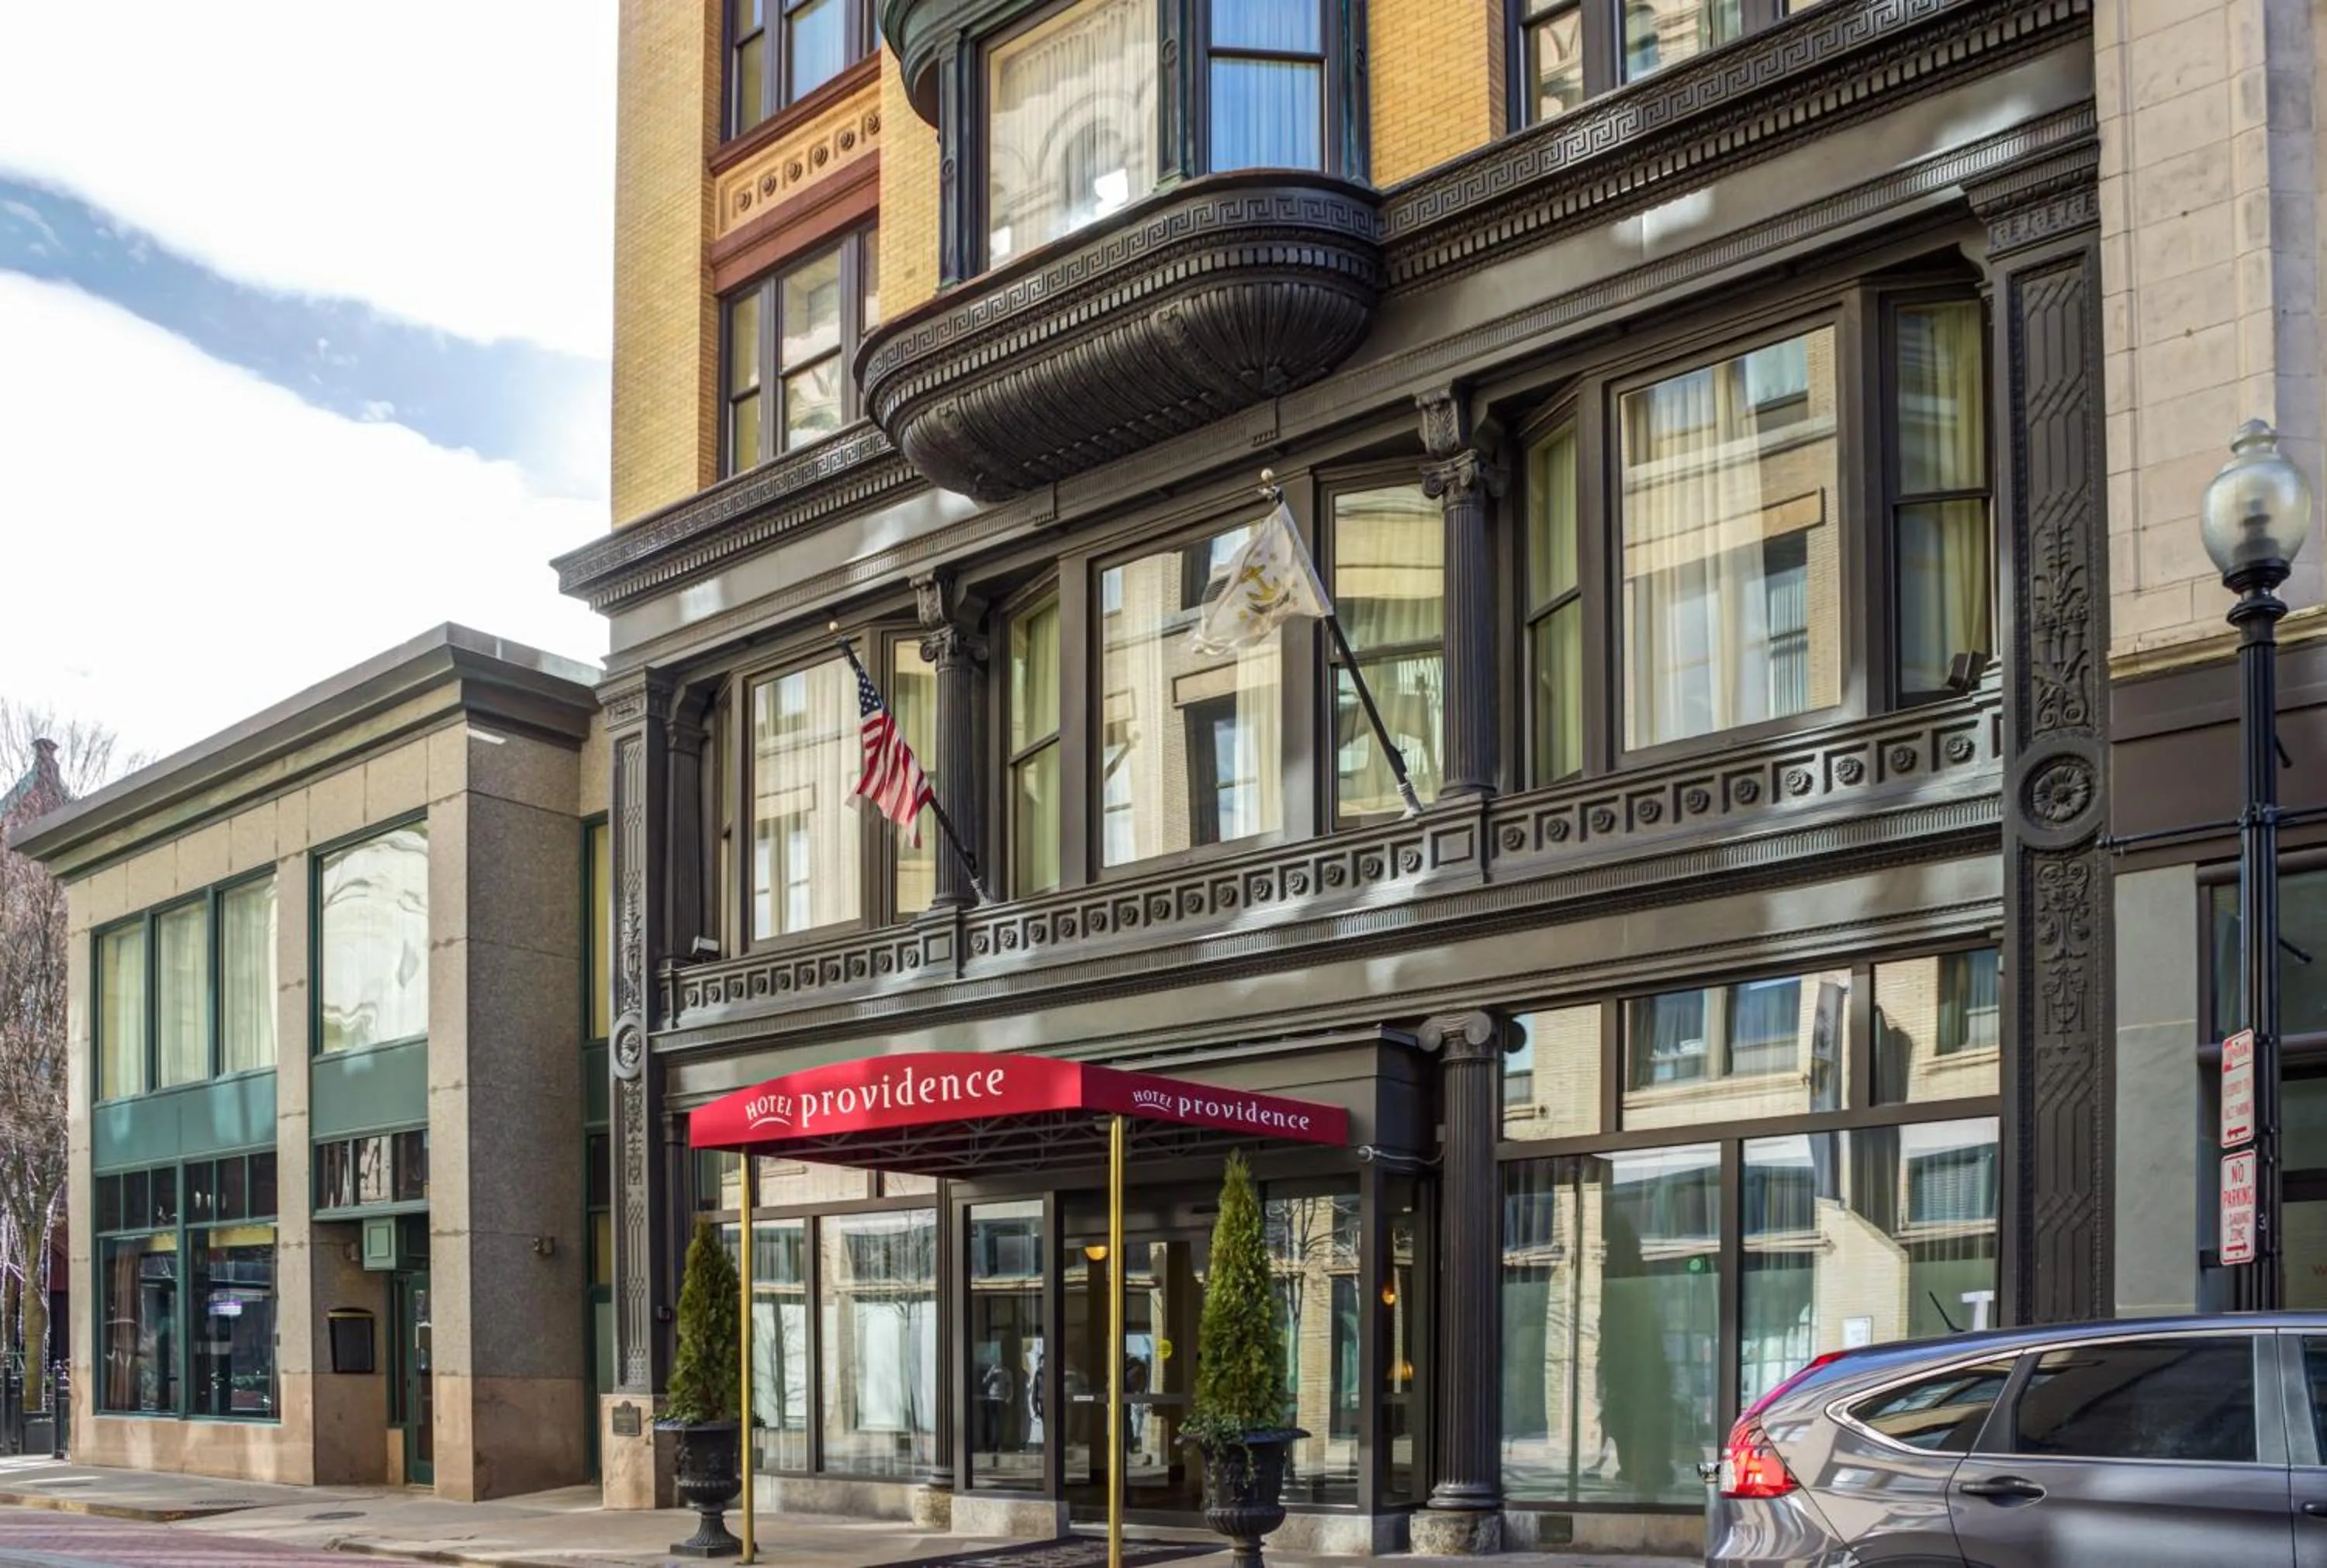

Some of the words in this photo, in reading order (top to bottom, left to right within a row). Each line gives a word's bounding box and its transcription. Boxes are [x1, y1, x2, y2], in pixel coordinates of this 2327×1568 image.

[745, 1095, 794, 1121] HOTEL
[800, 1067, 1004, 1128] providence
[1132, 1089, 1172, 1108] HOTEL
[1178, 1095, 1309, 1130] providence
[2231, 1163, 2244, 1182] NO
[2223, 1186, 2253, 1207] PARKING
